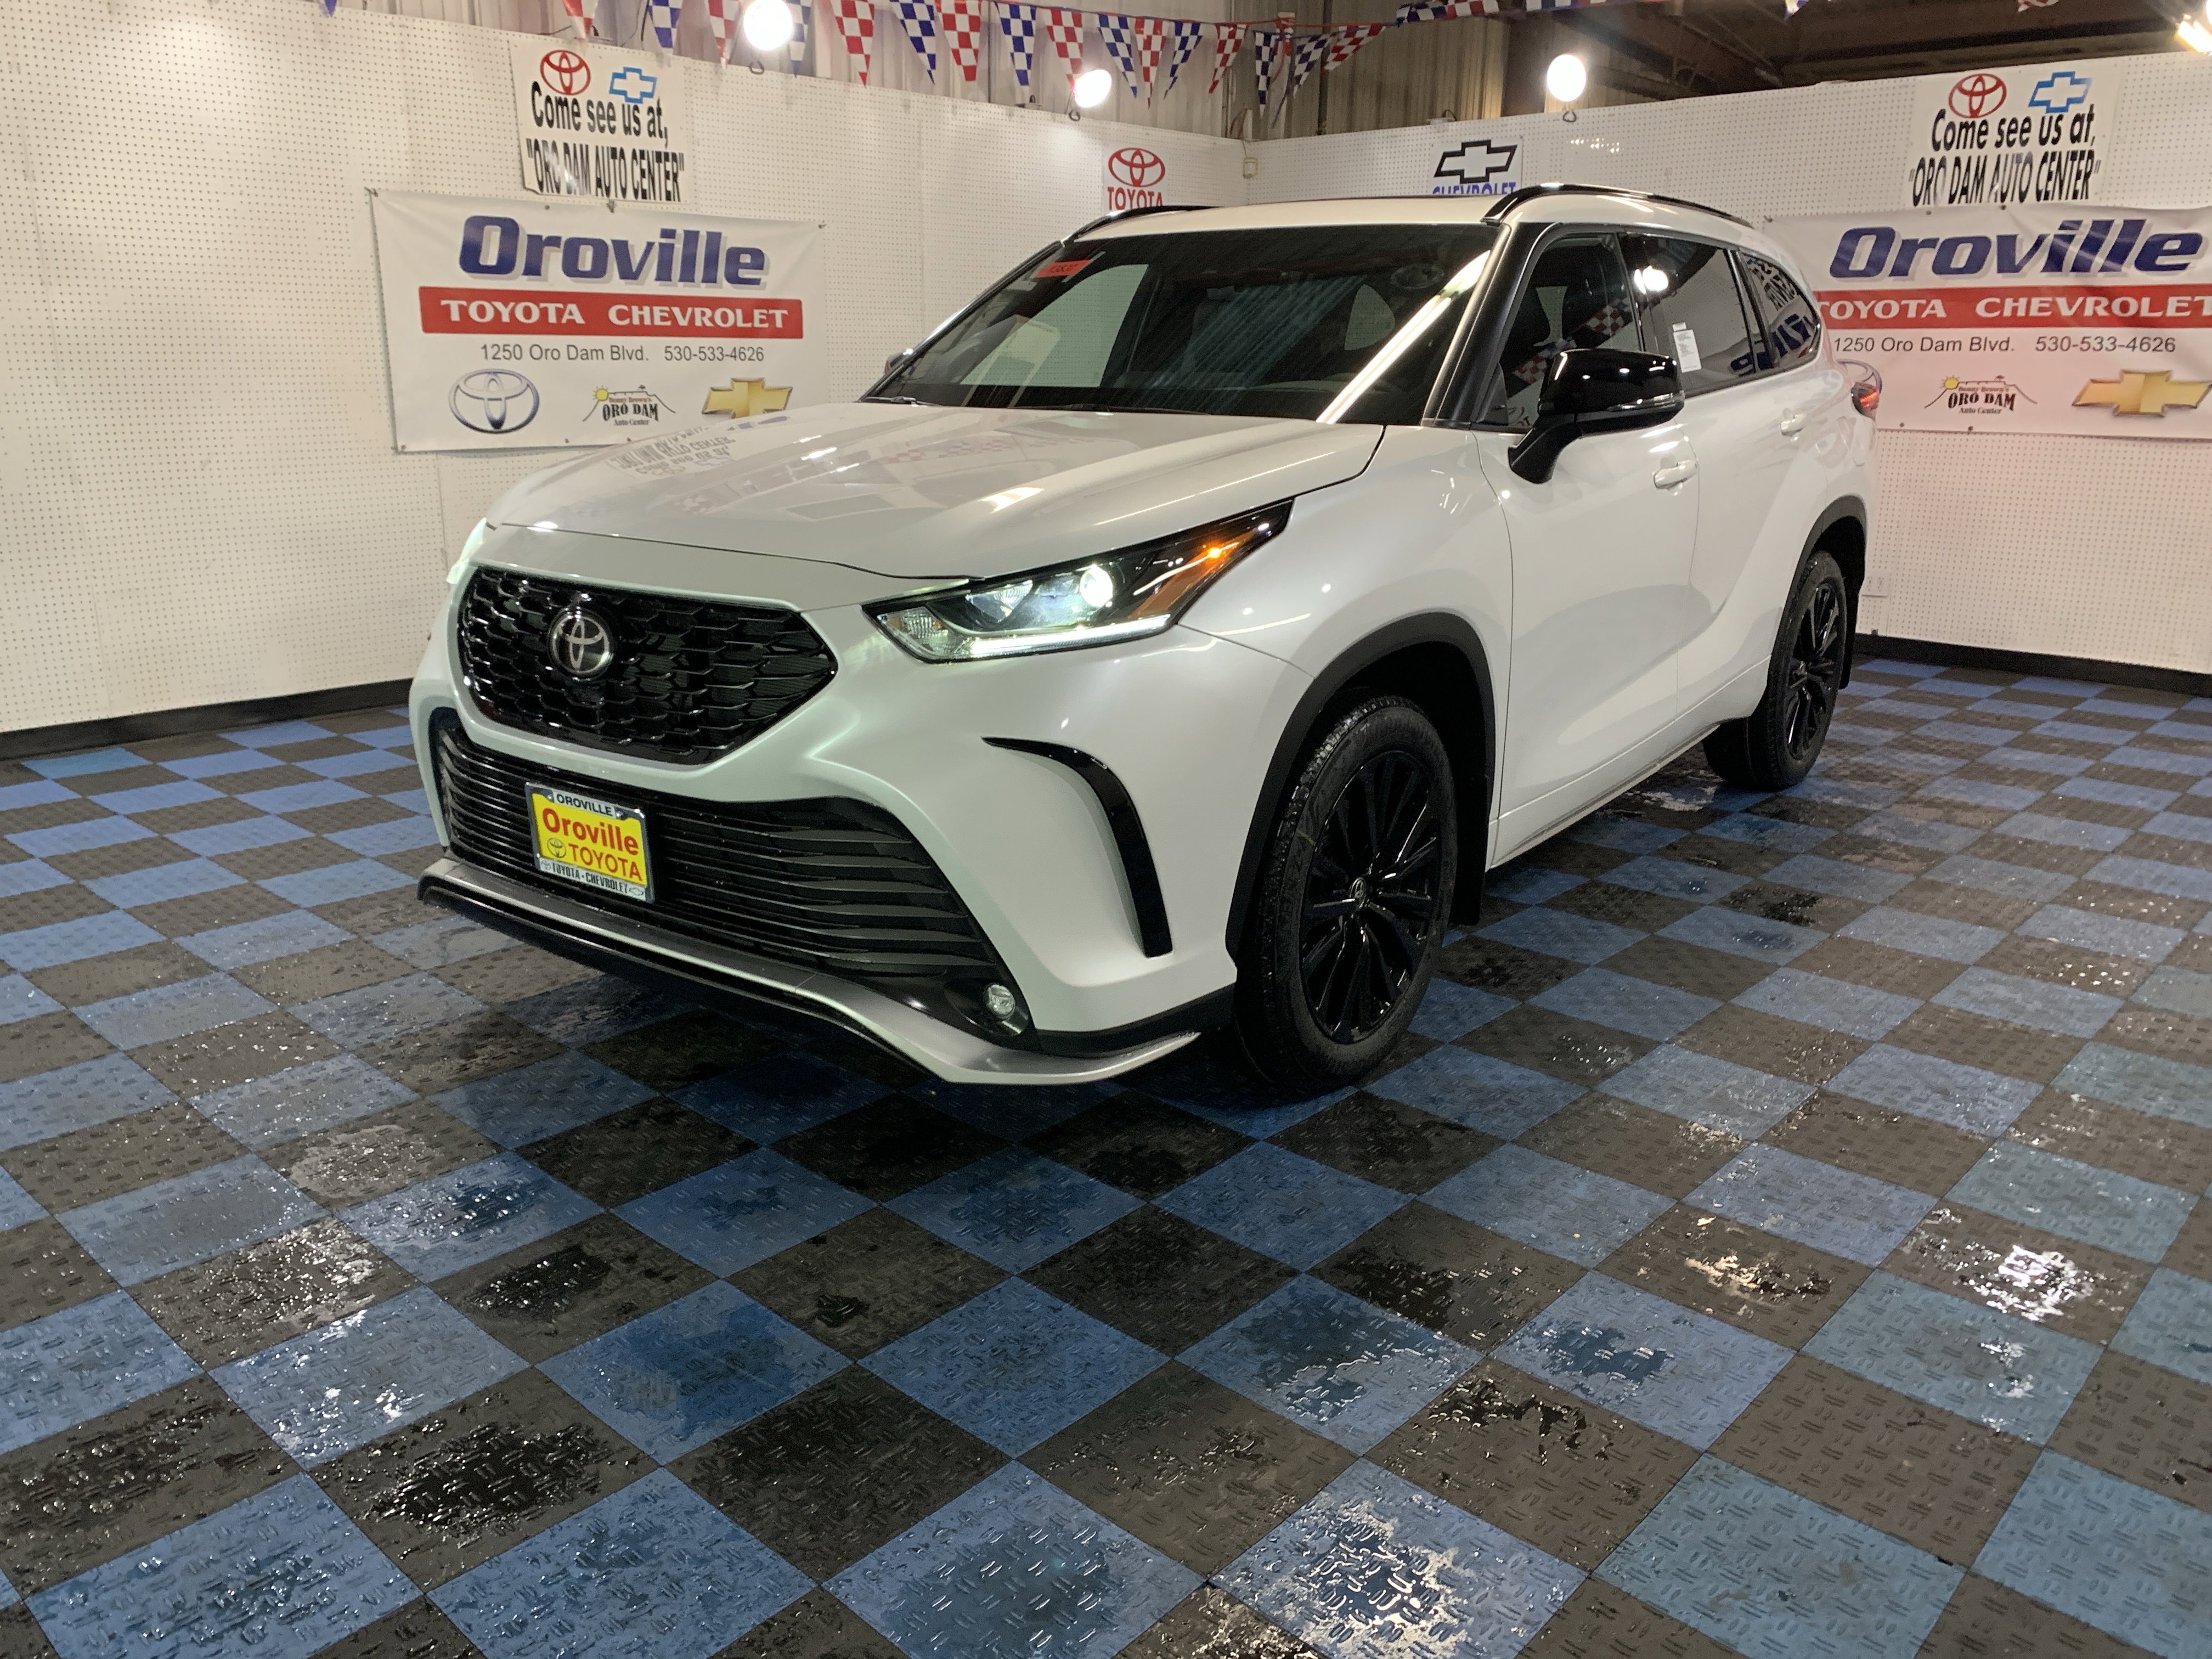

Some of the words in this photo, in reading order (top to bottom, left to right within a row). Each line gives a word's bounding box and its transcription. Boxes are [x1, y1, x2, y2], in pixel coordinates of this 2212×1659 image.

[531, 81, 581, 131] Come
[586, 99, 616, 134] see
[622, 103, 641, 137] us
[647, 96, 668, 148] at,
[1932, 109, 1988, 151] Come
[1994, 116, 2032, 148] see
[2039, 114, 2064, 146] us
[2070, 104, 2096, 146] at,
[563, 142, 591, 195] DAM
[595, 145, 627, 199] AUTO
[631, 148, 684, 202] CENTER"
[1949, 155, 1988, 204] DAM
[1988, 151, 2033, 204] AUTO
[2036, 149, 2101, 202] CENTER"
[1107, 187, 1163, 210] TOYOTA
[459, 215, 765, 285] Oroville
[1829, 219, 2203, 278] Oroville
[441, 300, 585, 325] TOYOTA
[608, 304, 788, 329] CHEVROLET
[1975, 295, 2212, 318] CHEVROLET
[481, 344, 522, 361] 1250
[529, 344, 561, 362] Oro
[567, 344, 605, 362] Dam
[610, 345, 649, 362] Blvd.
[664, 345, 764, 362] 530-533-4626
[1835, 337, 1875, 352] 1250
[1881, 337, 1914, 352] Oro
[1920, 336, 1961, 352] Dam
[1969, 336, 2015, 352] Blvd.
[2035, 336, 2176, 353] 530-533-4626
[602, 403, 629, 421] ORO
[633, 403, 659, 421] DAM
[1948, 392, 1979, 409] ORO
[1984, 393, 2016, 411] DAM
[556, 794, 613, 817] OROVILLE
[542, 808, 639, 856] Oroville
[568, 843, 643, 882] TOYOTA
[552, 863, 580, 879] TOYOTA
[585, 872, 629, 894] CHEVROLET
